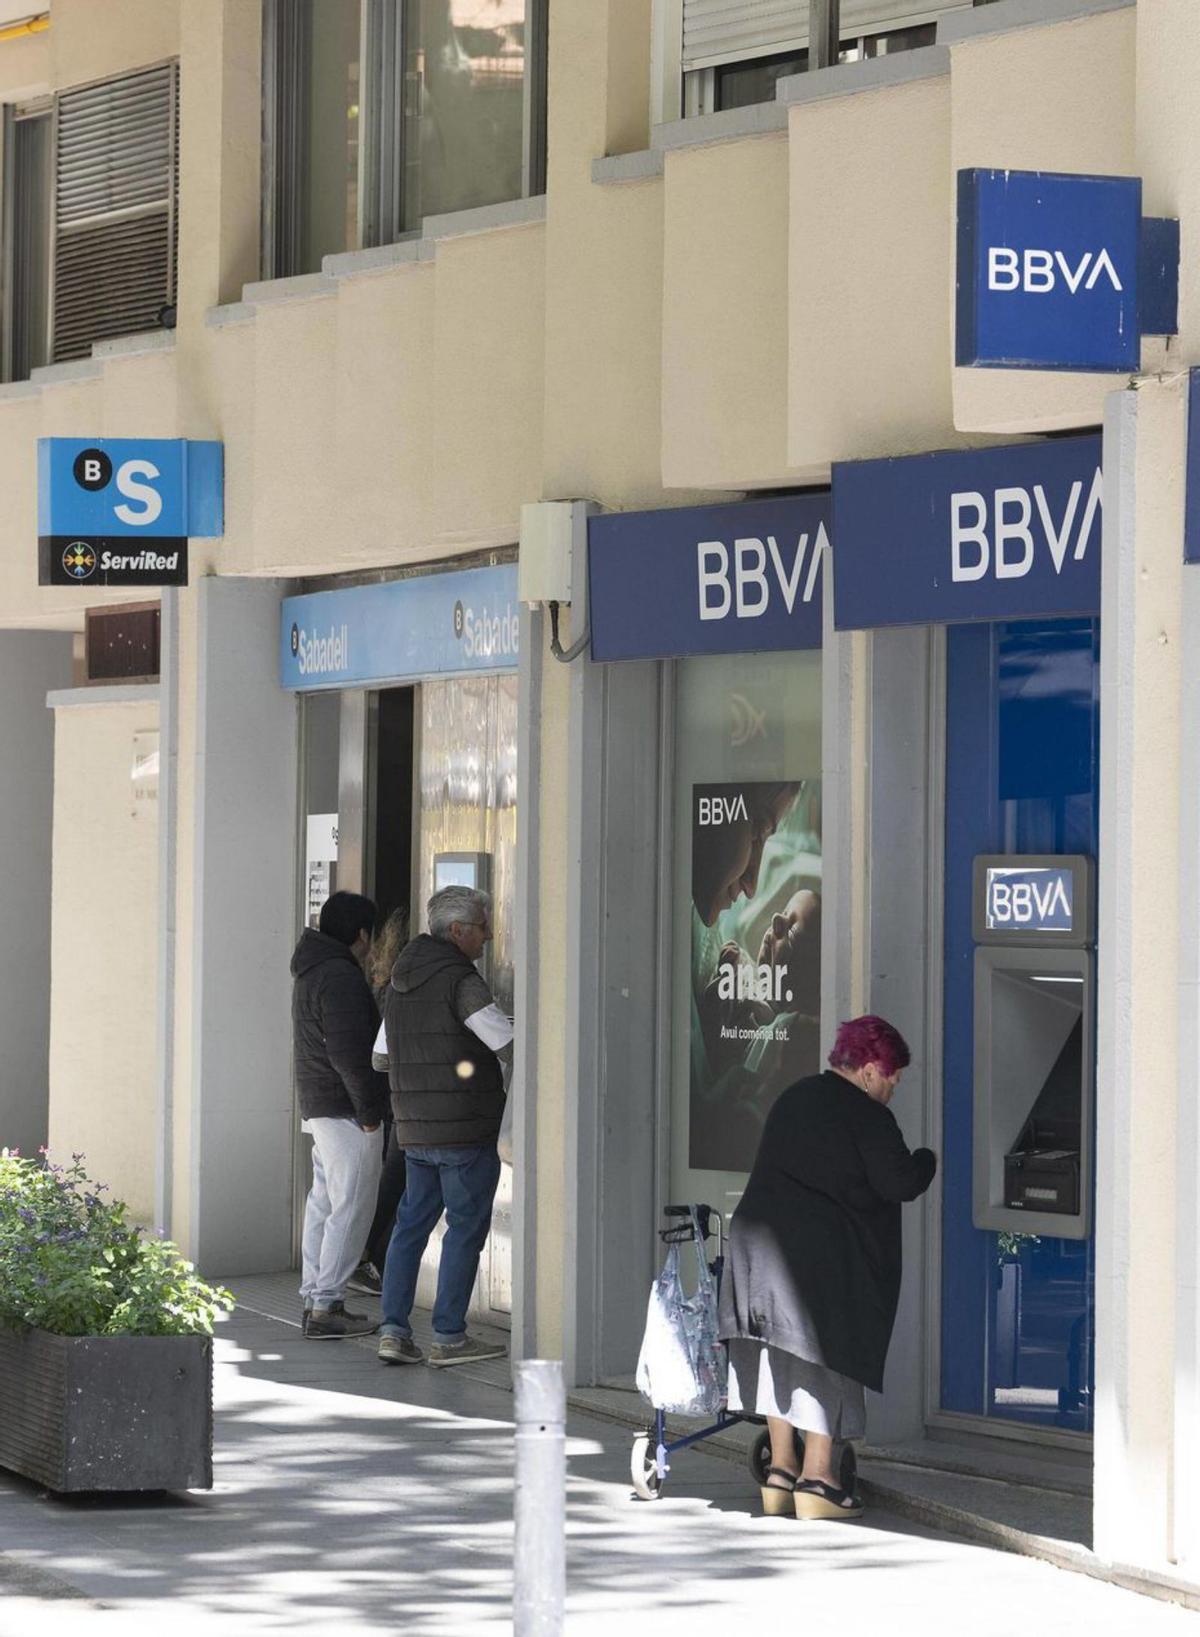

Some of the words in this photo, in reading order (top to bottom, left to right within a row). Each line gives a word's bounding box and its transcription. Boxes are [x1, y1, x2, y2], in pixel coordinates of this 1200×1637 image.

[988, 247, 1123, 294] BBVA
[84, 460, 101, 481] B
[113, 459, 163, 526] S
[100, 550, 179, 570] ServiRed
[298, 623, 348, 674] Sabadell
[699, 794, 748, 825] BBVA
[992, 876, 1071, 922] BBVA
[720, 1025, 738, 1039] Avui
[775, 1027, 790, 1041] tot.
